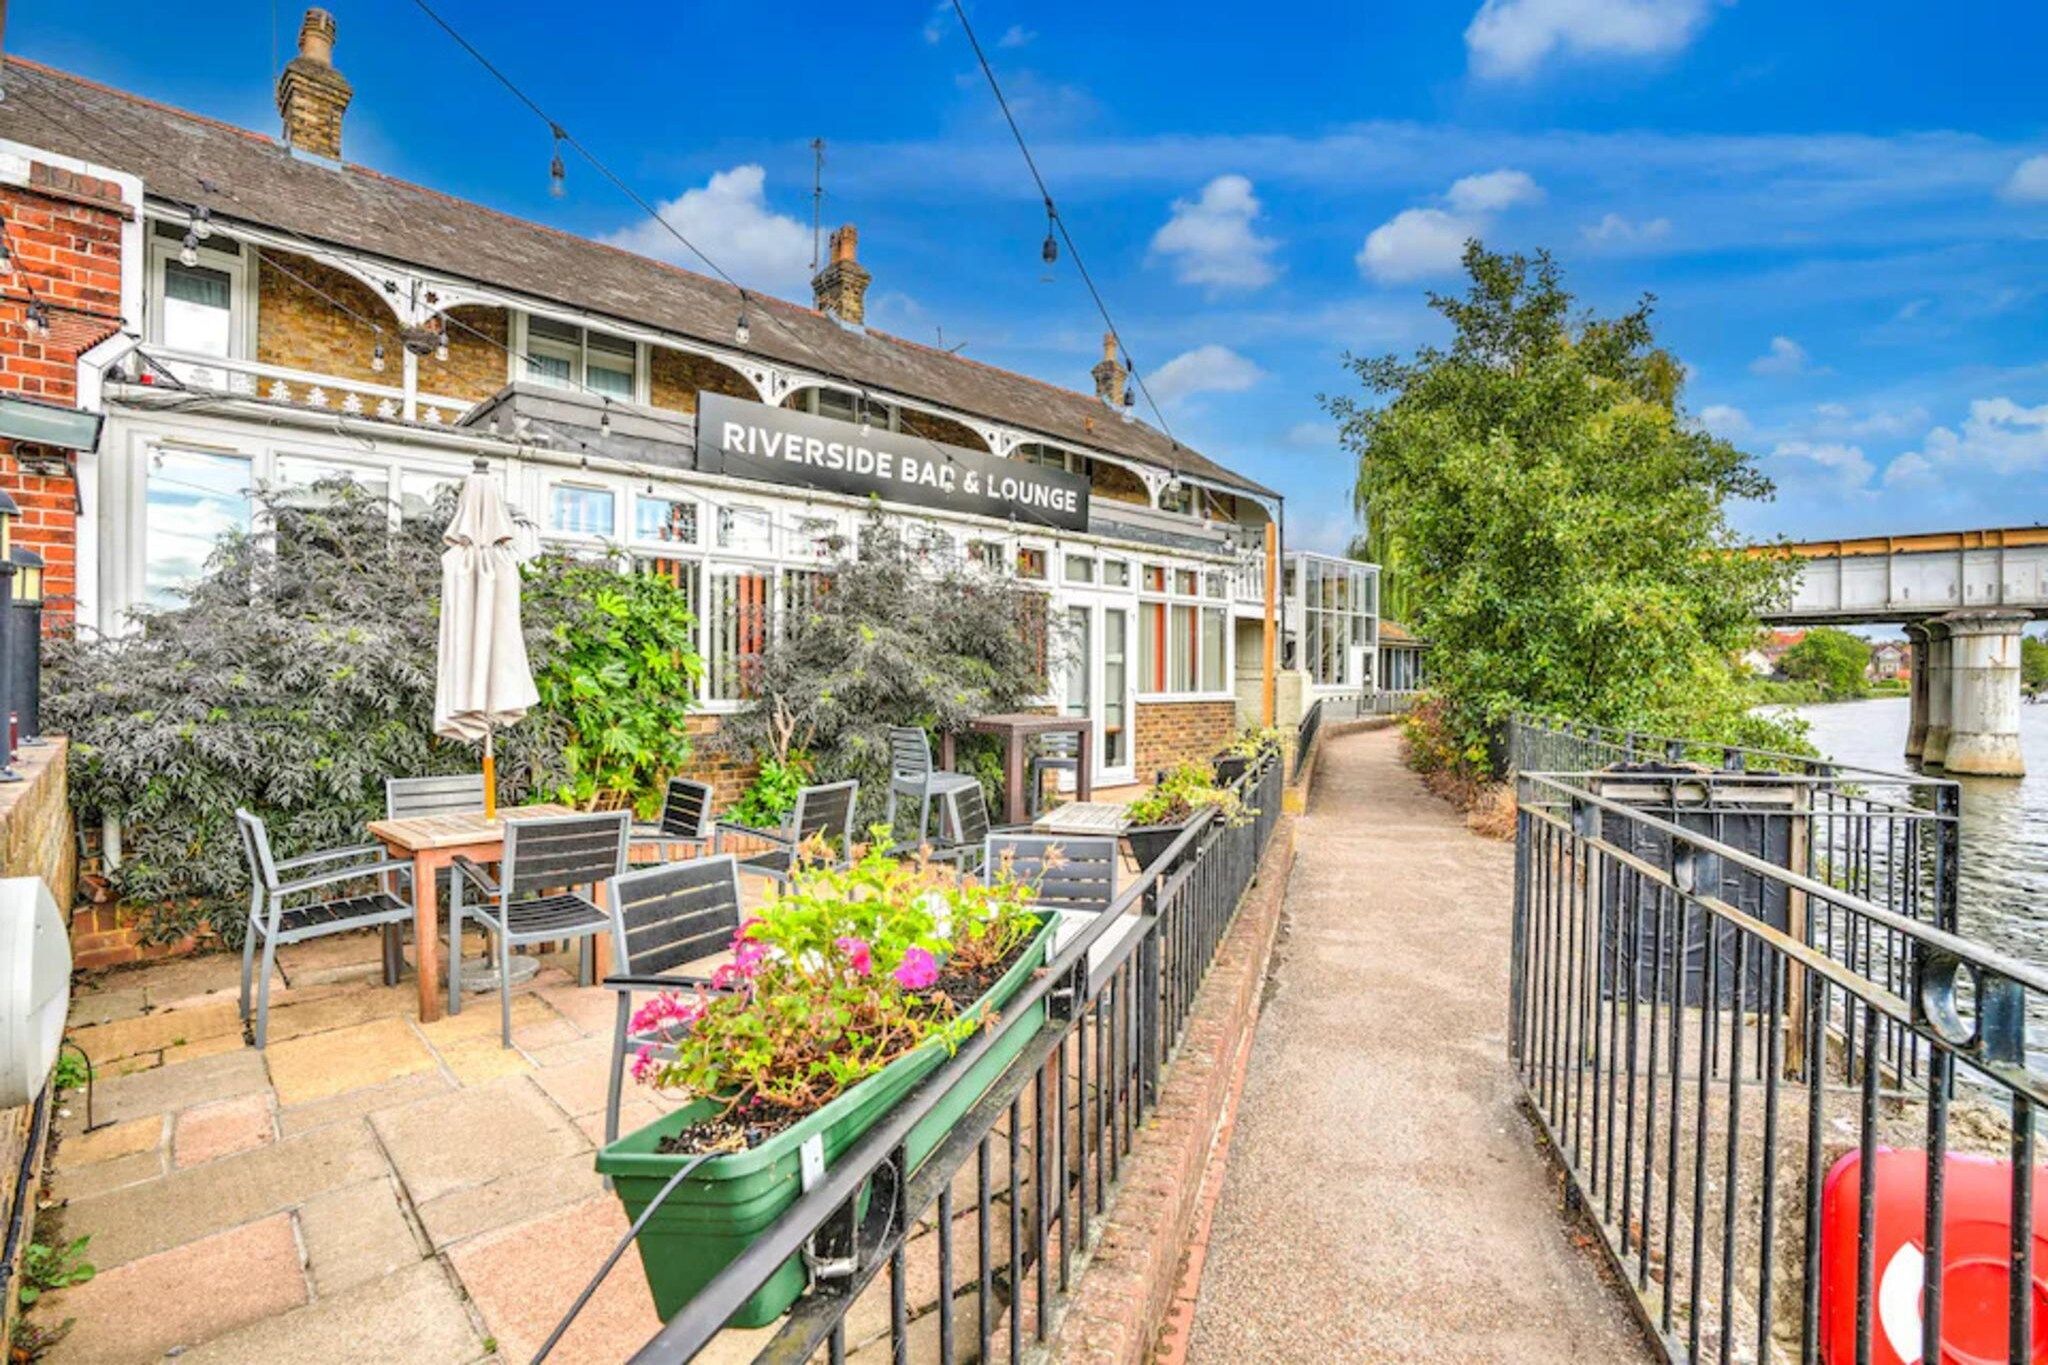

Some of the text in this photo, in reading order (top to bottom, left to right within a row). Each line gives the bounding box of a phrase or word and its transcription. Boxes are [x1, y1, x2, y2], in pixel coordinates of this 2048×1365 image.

[723, 422, 893, 478] RIVERSIDE
[963, 470, 980, 494] &
[987, 474, 1077, 513] LOUNGE
